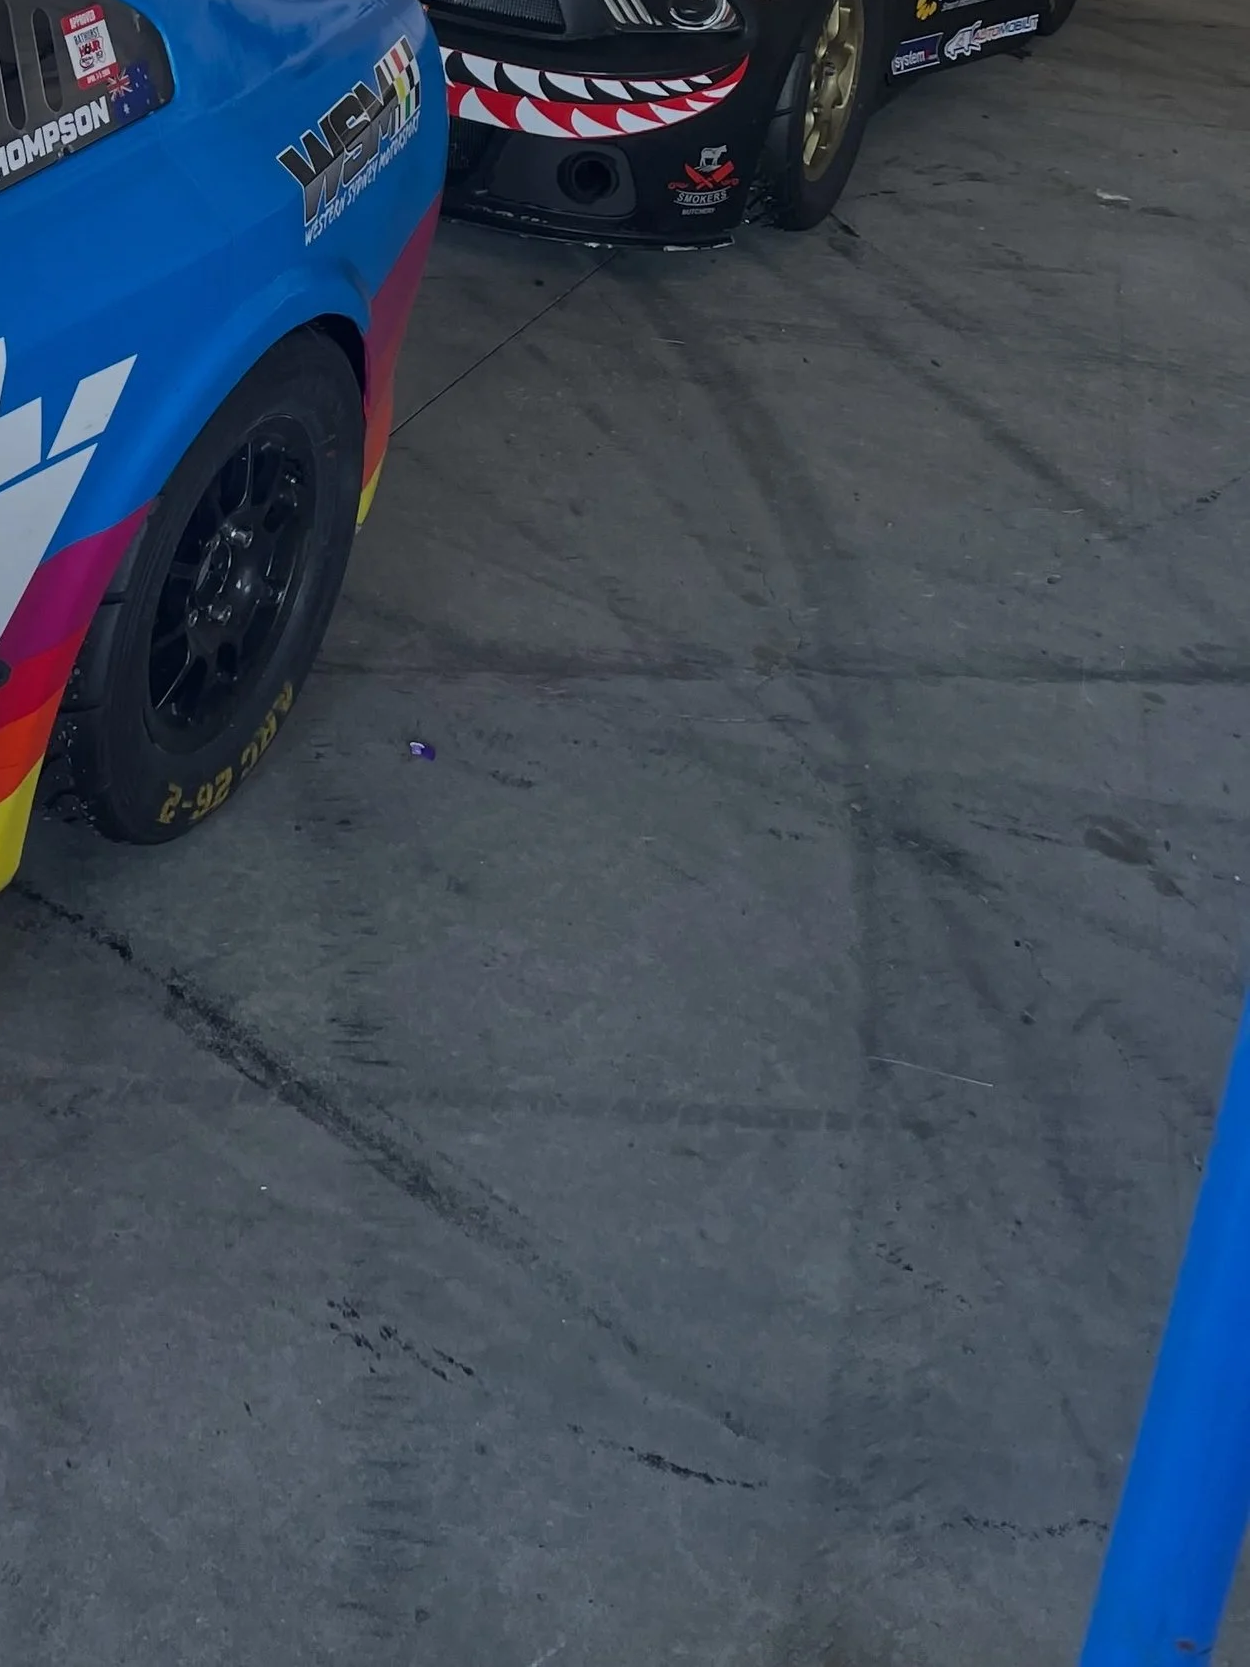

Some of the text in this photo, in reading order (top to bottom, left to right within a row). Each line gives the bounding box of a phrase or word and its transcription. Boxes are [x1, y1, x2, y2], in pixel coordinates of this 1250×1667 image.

[74, 26, 100, 45] BATHURST
[304, 193, 346, 246] WESTERN
[347, 160, 376, 207] SYDNEY
[677, 189, 727, 203] SMOKERS
